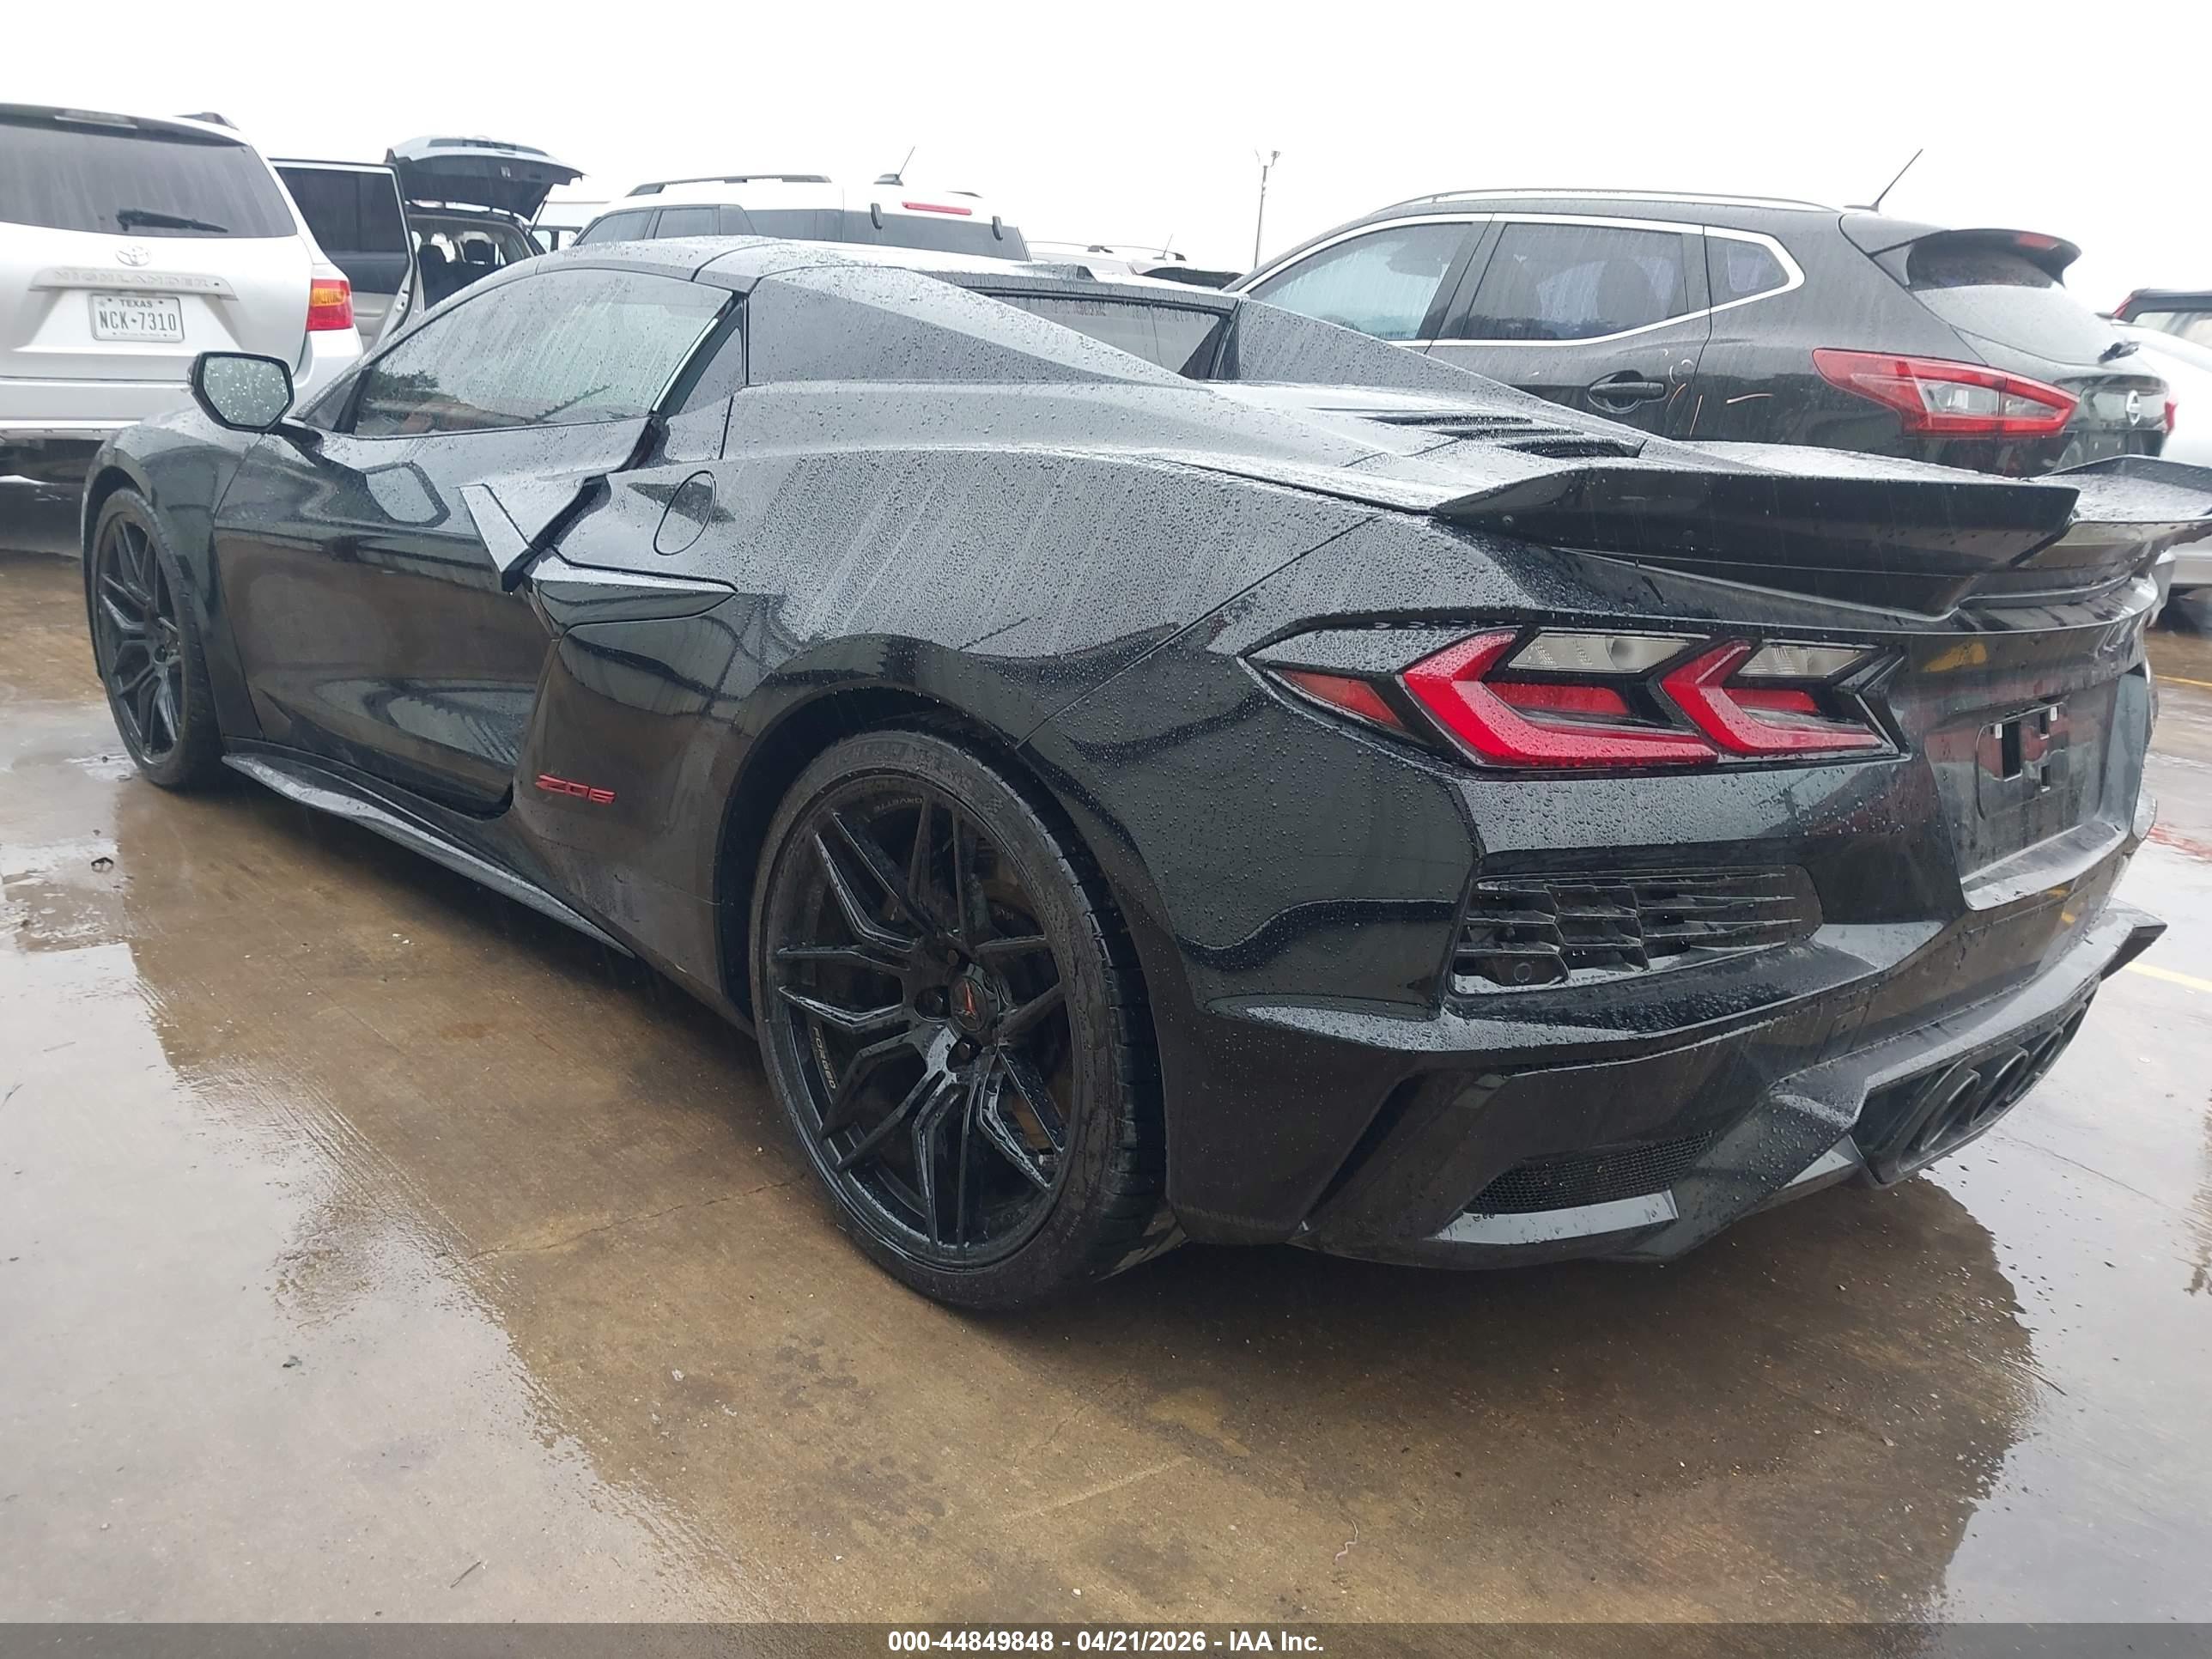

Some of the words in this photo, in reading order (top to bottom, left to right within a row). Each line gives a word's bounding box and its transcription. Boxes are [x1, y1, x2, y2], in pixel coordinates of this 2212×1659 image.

[54, 270, 209, 287] HIGHLANDER
[120, 299, 153, 308] TEXAS
[535, 774, 617, 804] Z06
[873, 797, 923, 811] ORVETTE
[812, 1026, 836, 1089] FORGED
